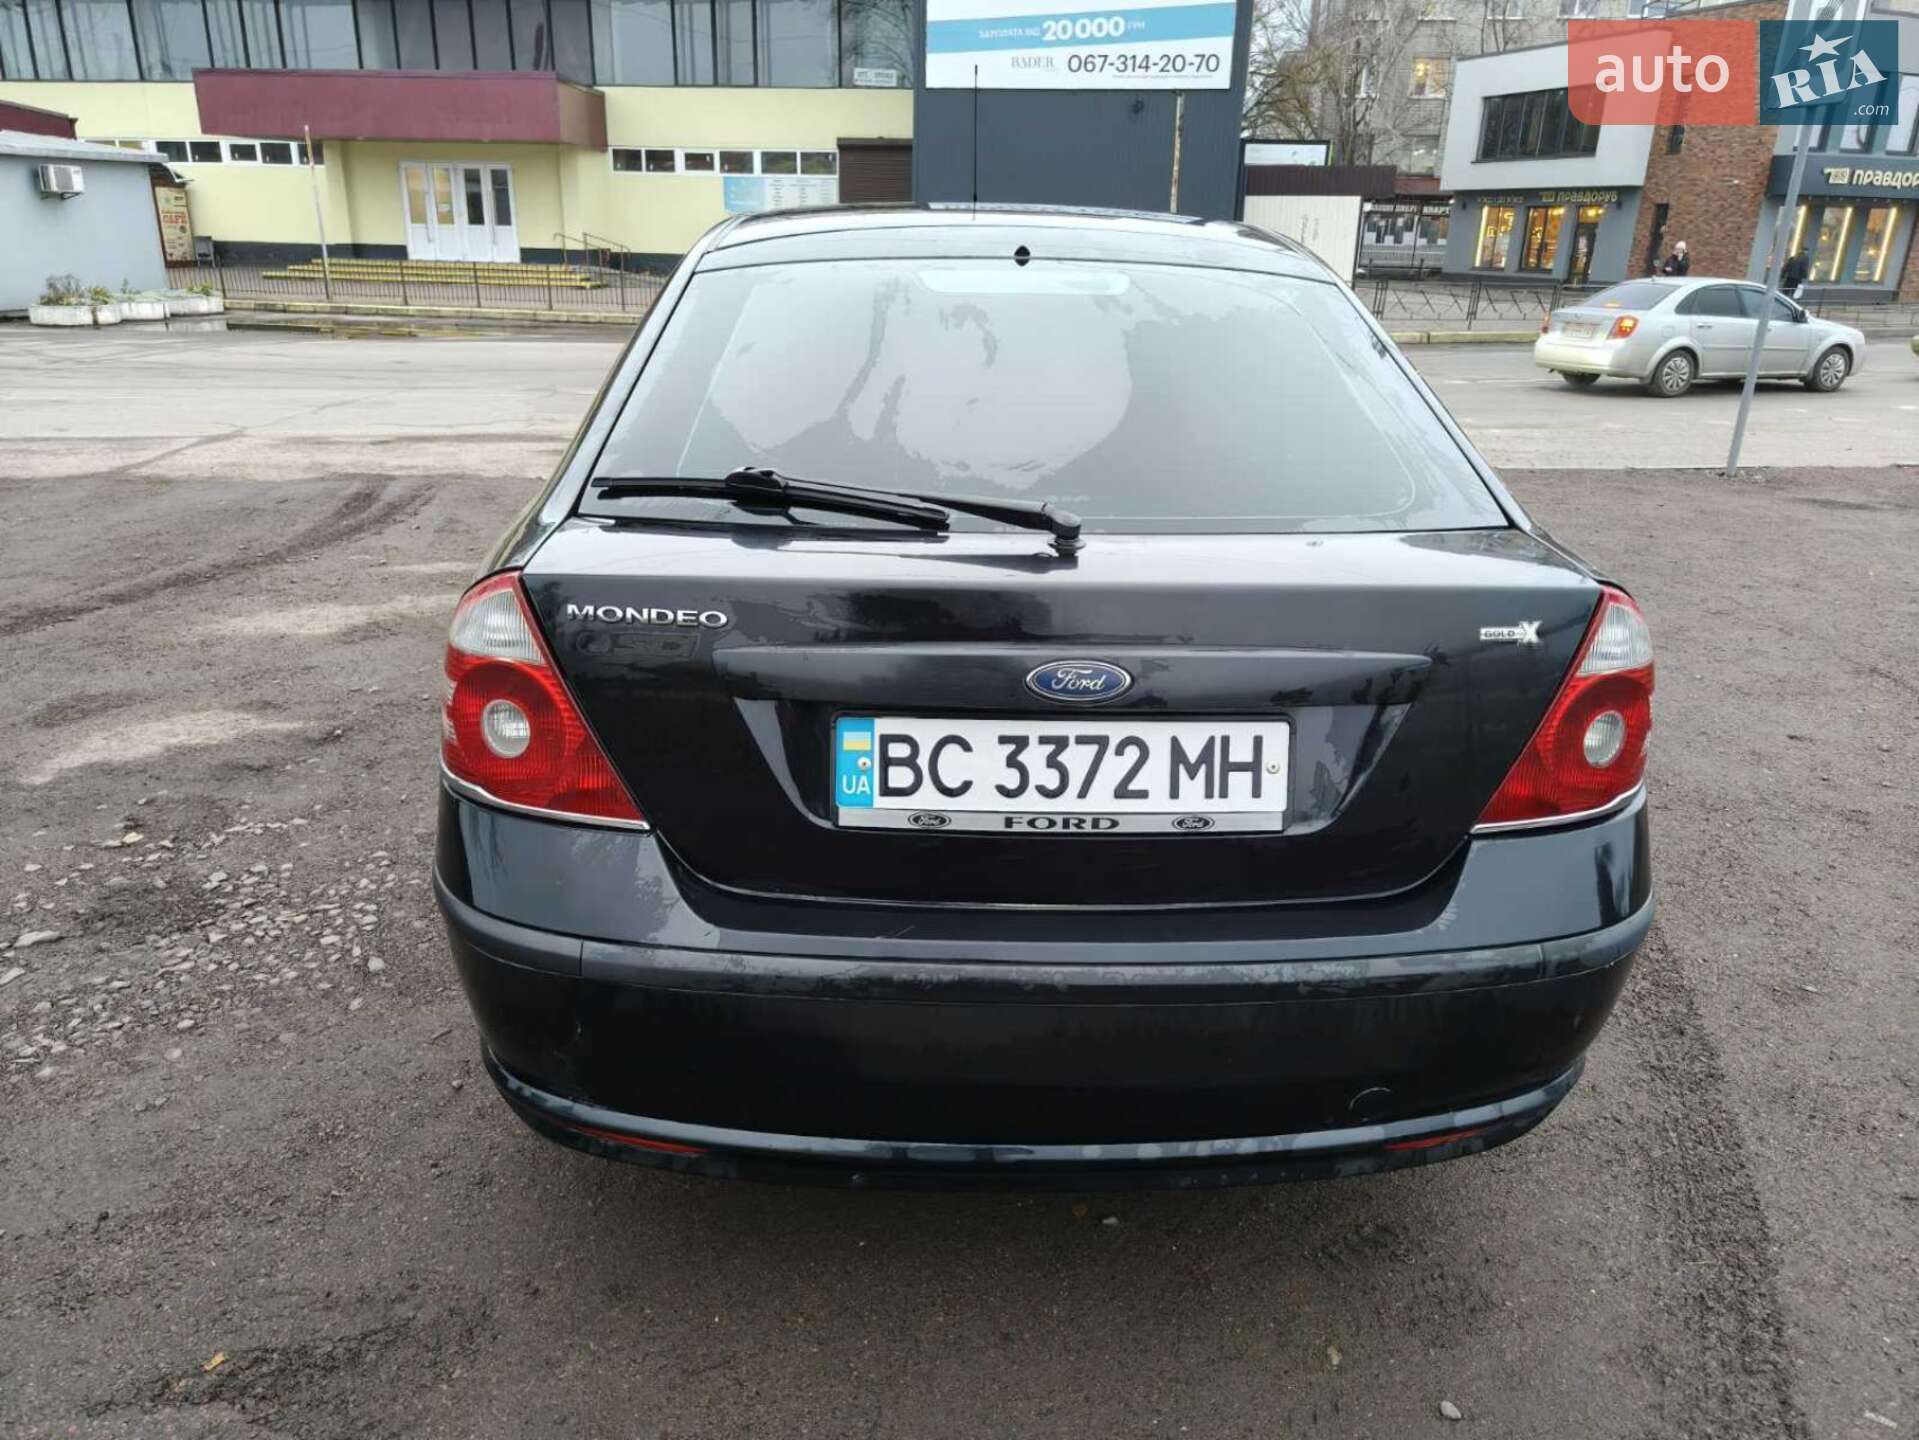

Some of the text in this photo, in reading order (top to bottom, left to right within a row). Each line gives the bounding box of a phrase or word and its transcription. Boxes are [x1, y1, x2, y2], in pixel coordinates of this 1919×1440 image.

[1067, 54, 1221, 73] 067-314-20-70
[566, 603, 729, 628] MONDEO
[1051, 667, 1107, 690] Ford
[879, 734, 1263, 800] BC 3372 MH
[842, 775, 872, 795] UA
[1003, 815, 1120, 831] FORD
